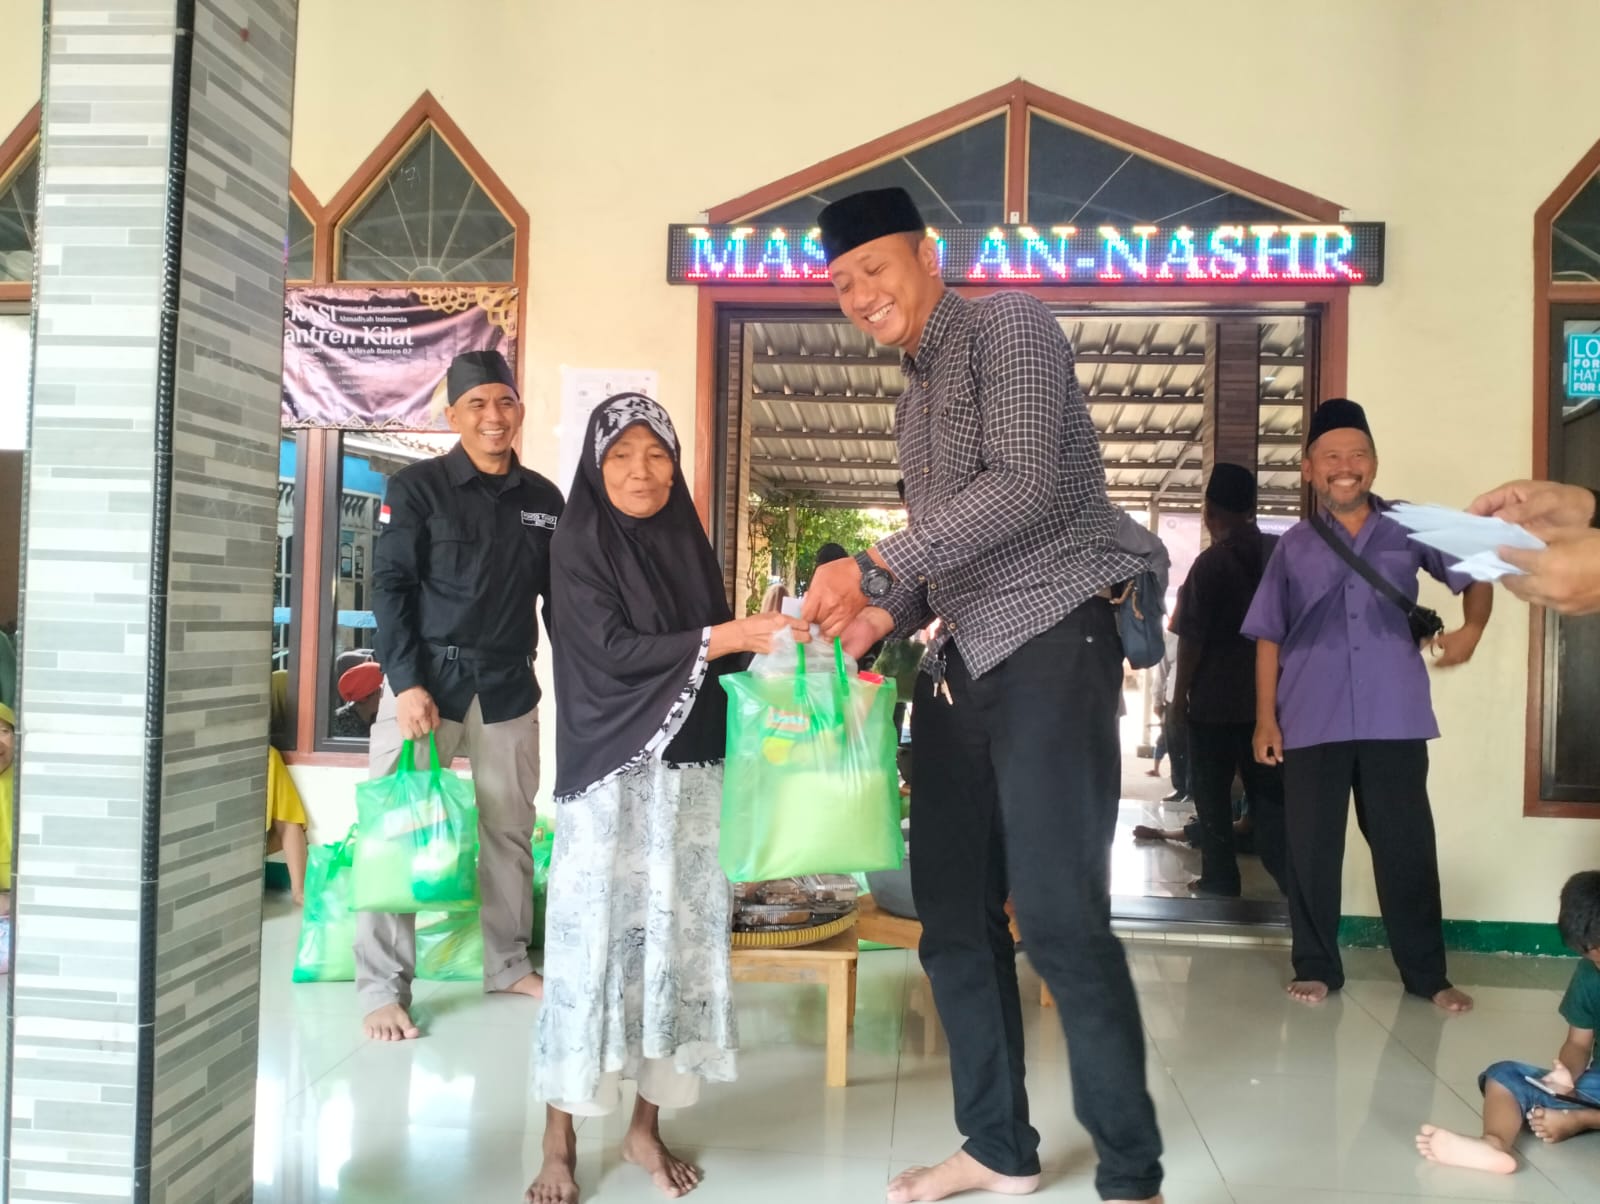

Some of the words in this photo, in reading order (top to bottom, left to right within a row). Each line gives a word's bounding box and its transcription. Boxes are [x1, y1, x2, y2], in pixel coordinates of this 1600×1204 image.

[686, 226, 944, 279] MAS
[968, 225, 1363, 280] AN-NASHR
[375, 315, 408, 324] Indonesia
[362, 326, 415, 345] Kilat
[1573, 358, 1600, 368] FOR
[1573, 382, 1596, 392] FOR
